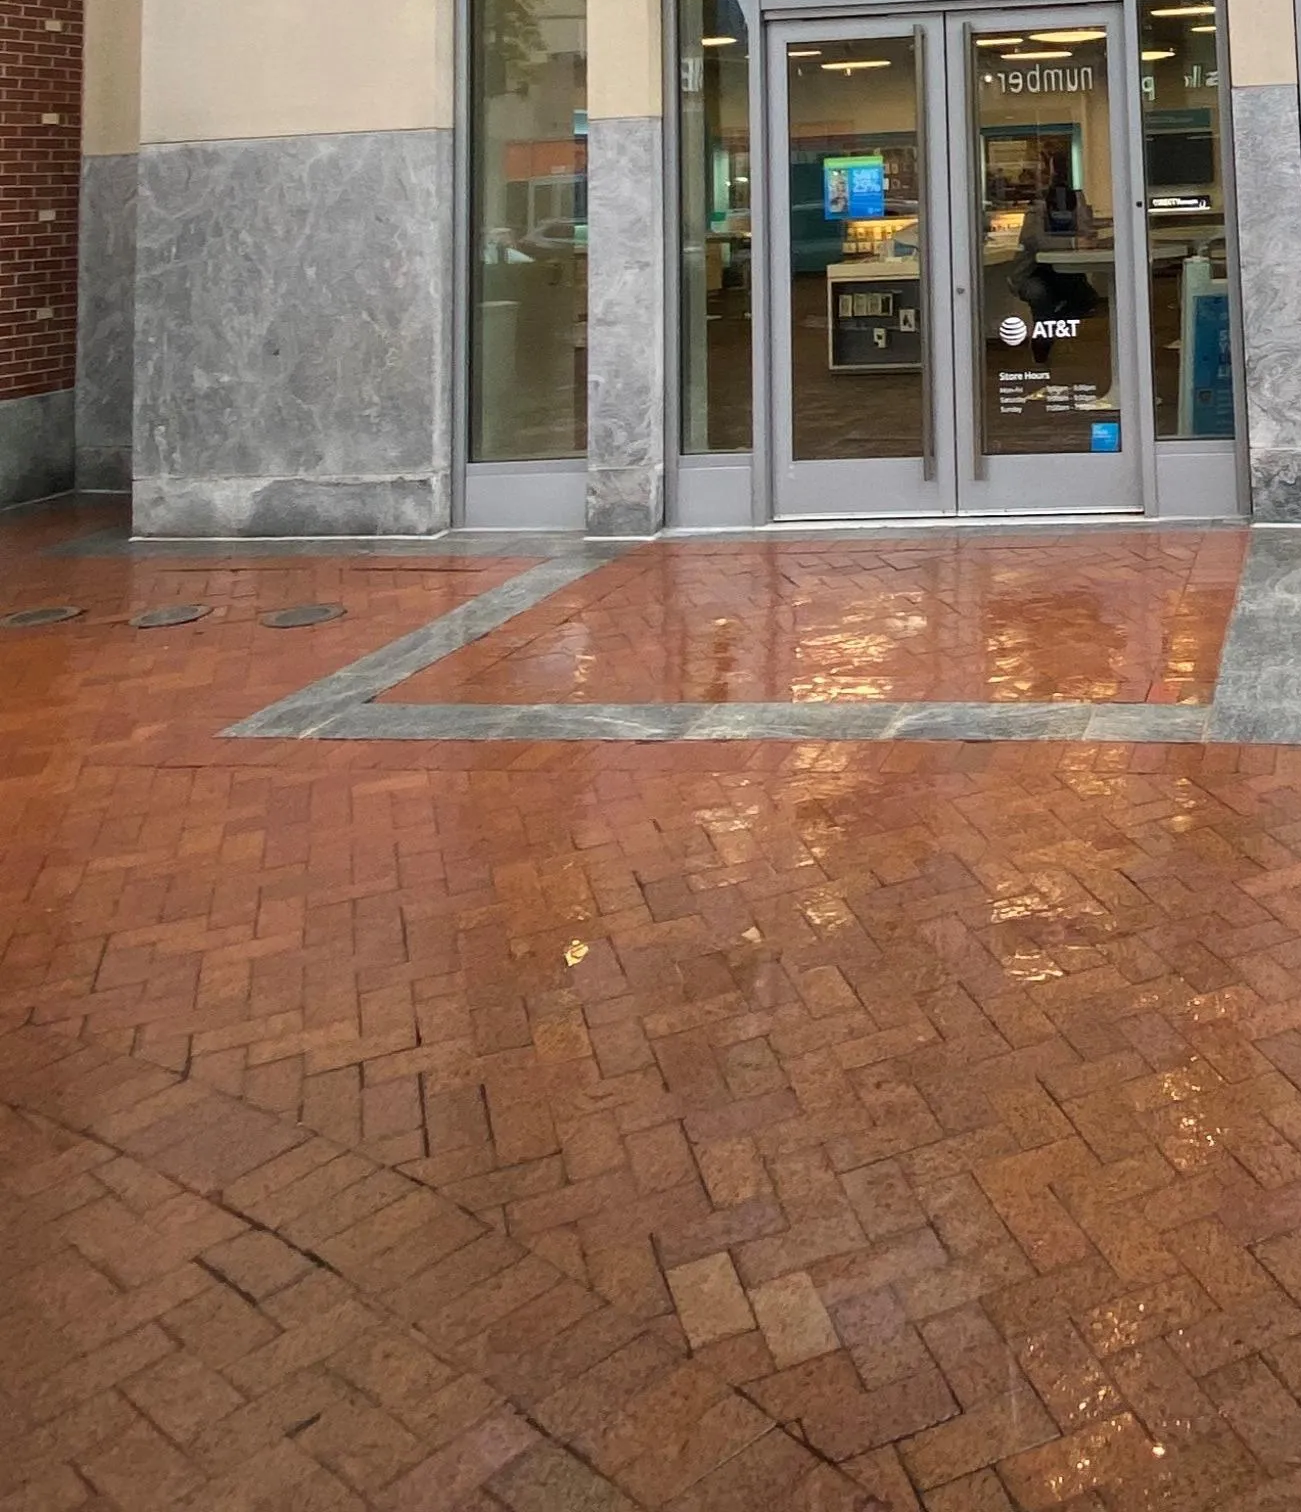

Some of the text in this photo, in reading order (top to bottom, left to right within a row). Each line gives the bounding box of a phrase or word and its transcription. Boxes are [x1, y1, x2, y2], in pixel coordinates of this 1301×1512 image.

[1031, 319, 1080, 339] AT&T
[999, 371, 1051, 381] Store Hours
